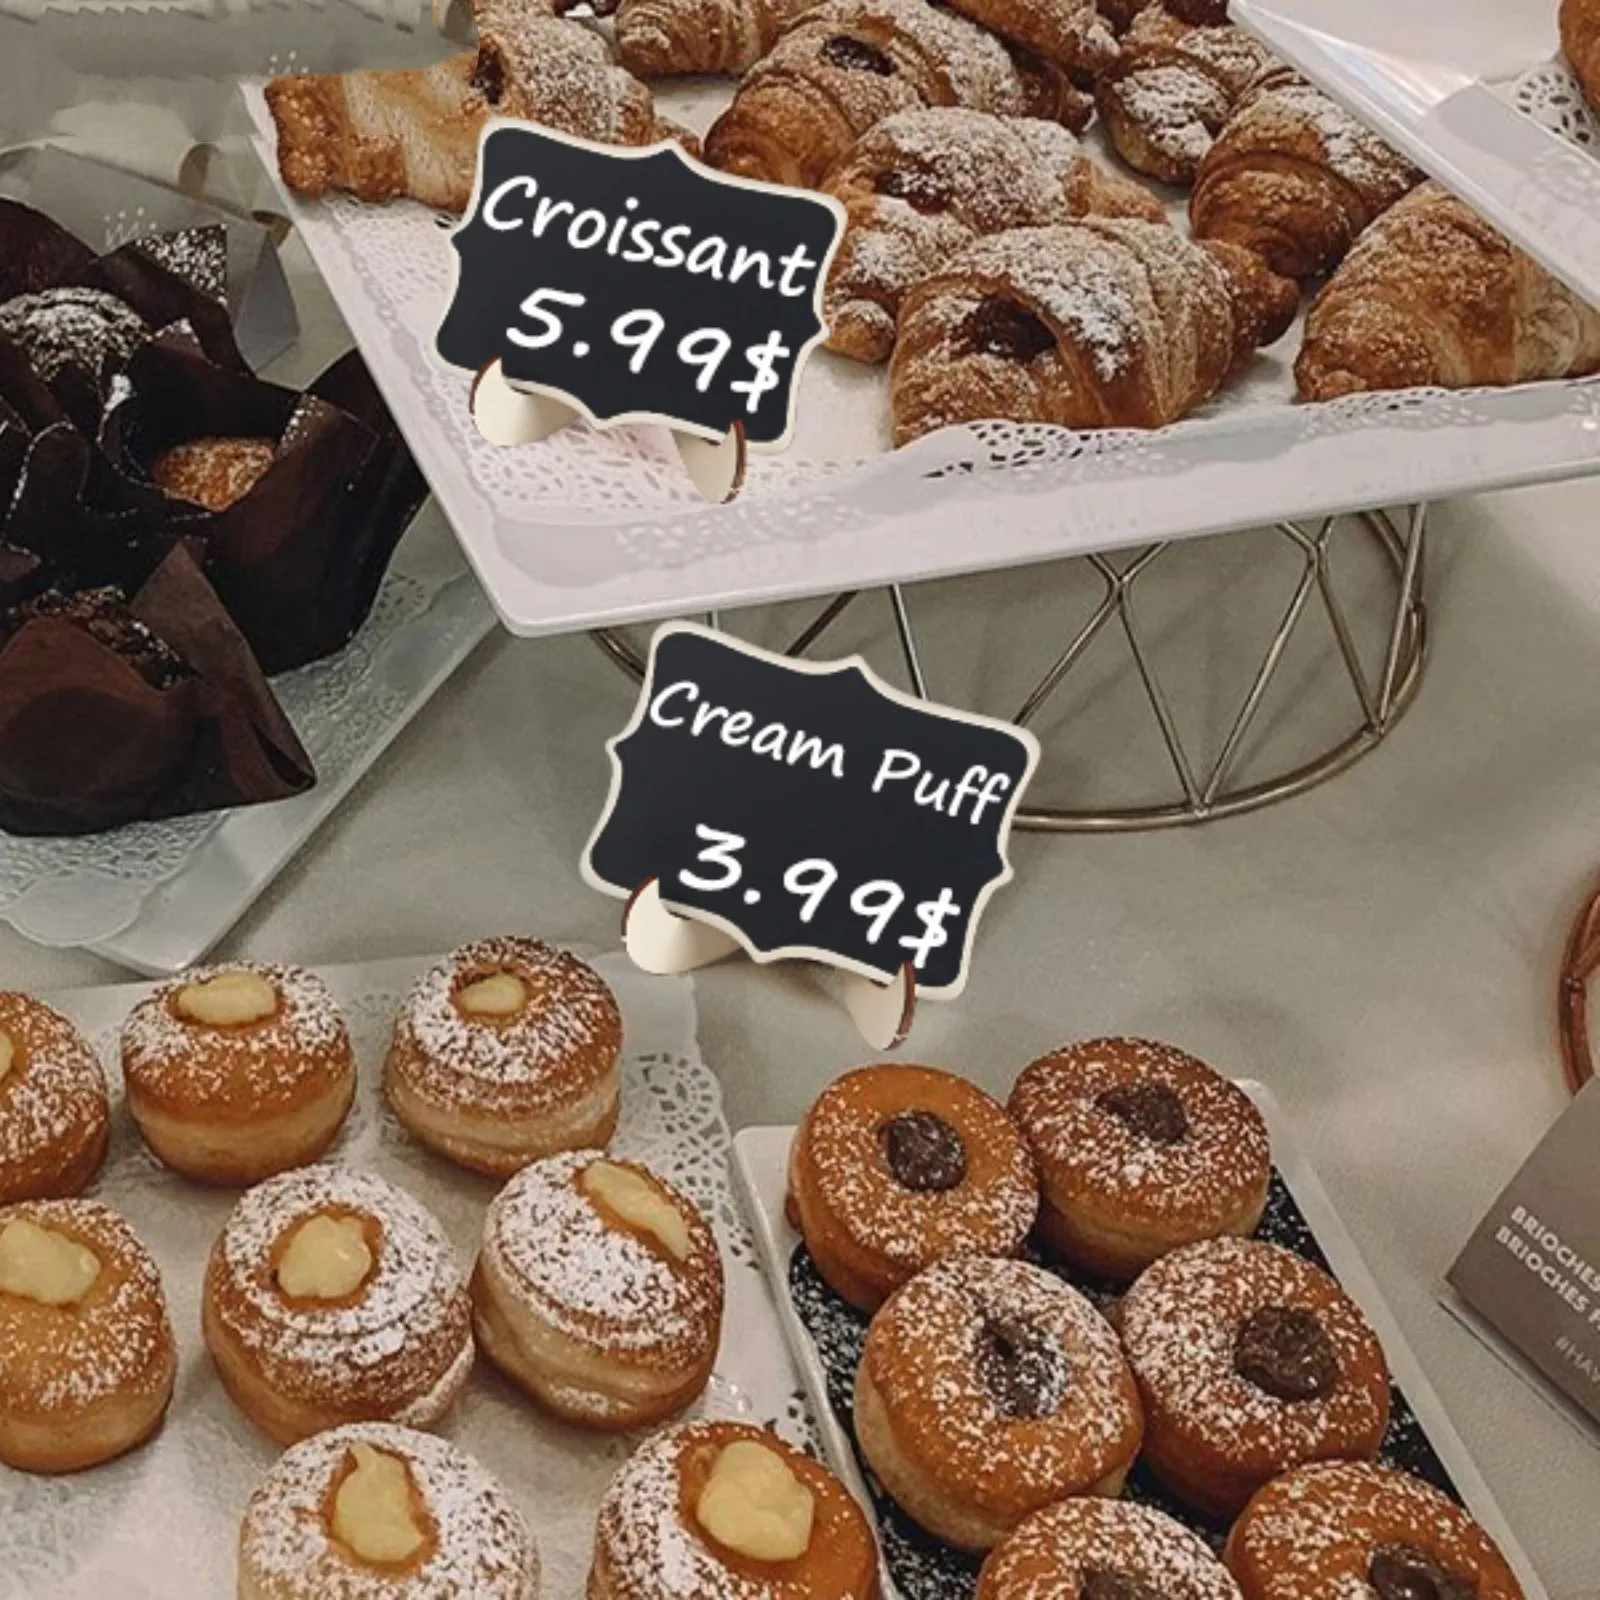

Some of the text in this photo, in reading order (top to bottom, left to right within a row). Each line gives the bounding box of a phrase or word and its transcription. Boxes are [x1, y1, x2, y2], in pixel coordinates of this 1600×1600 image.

[482, 175, 817, 297] Croissant
[506, 287, 790, 414] 5.99$
[649, 681, 1011, 825] Cream Puff
[678, 823, 961, 969] 3.99$
[1495, 1225, 1589, 1312] BRIOCHES
[1511, 1204, 1600, 1292] BRIOCHES
